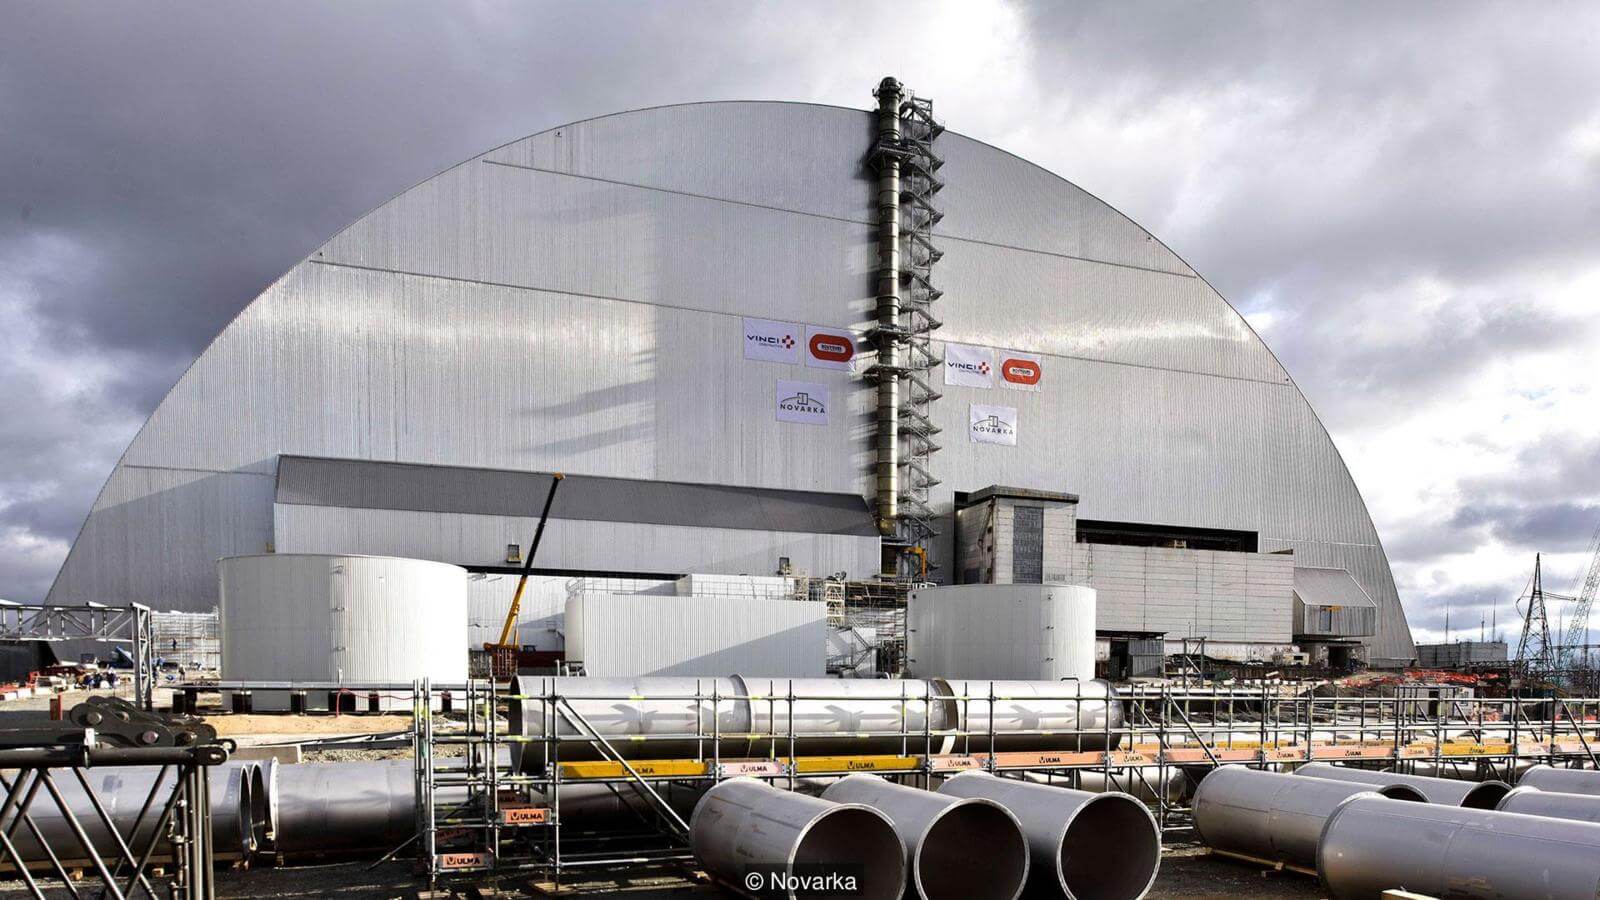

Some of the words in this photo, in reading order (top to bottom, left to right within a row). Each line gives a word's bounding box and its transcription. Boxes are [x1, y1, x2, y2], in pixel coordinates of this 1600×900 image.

[747, 334, 779, 344] VINCI
[948, 362, 976, 370] VINCI
[780, 403, 826, 414] NOVARKA
[973, 426, 1013, 435] NOVARKA
[521, 812, 542, 820] ULMA
